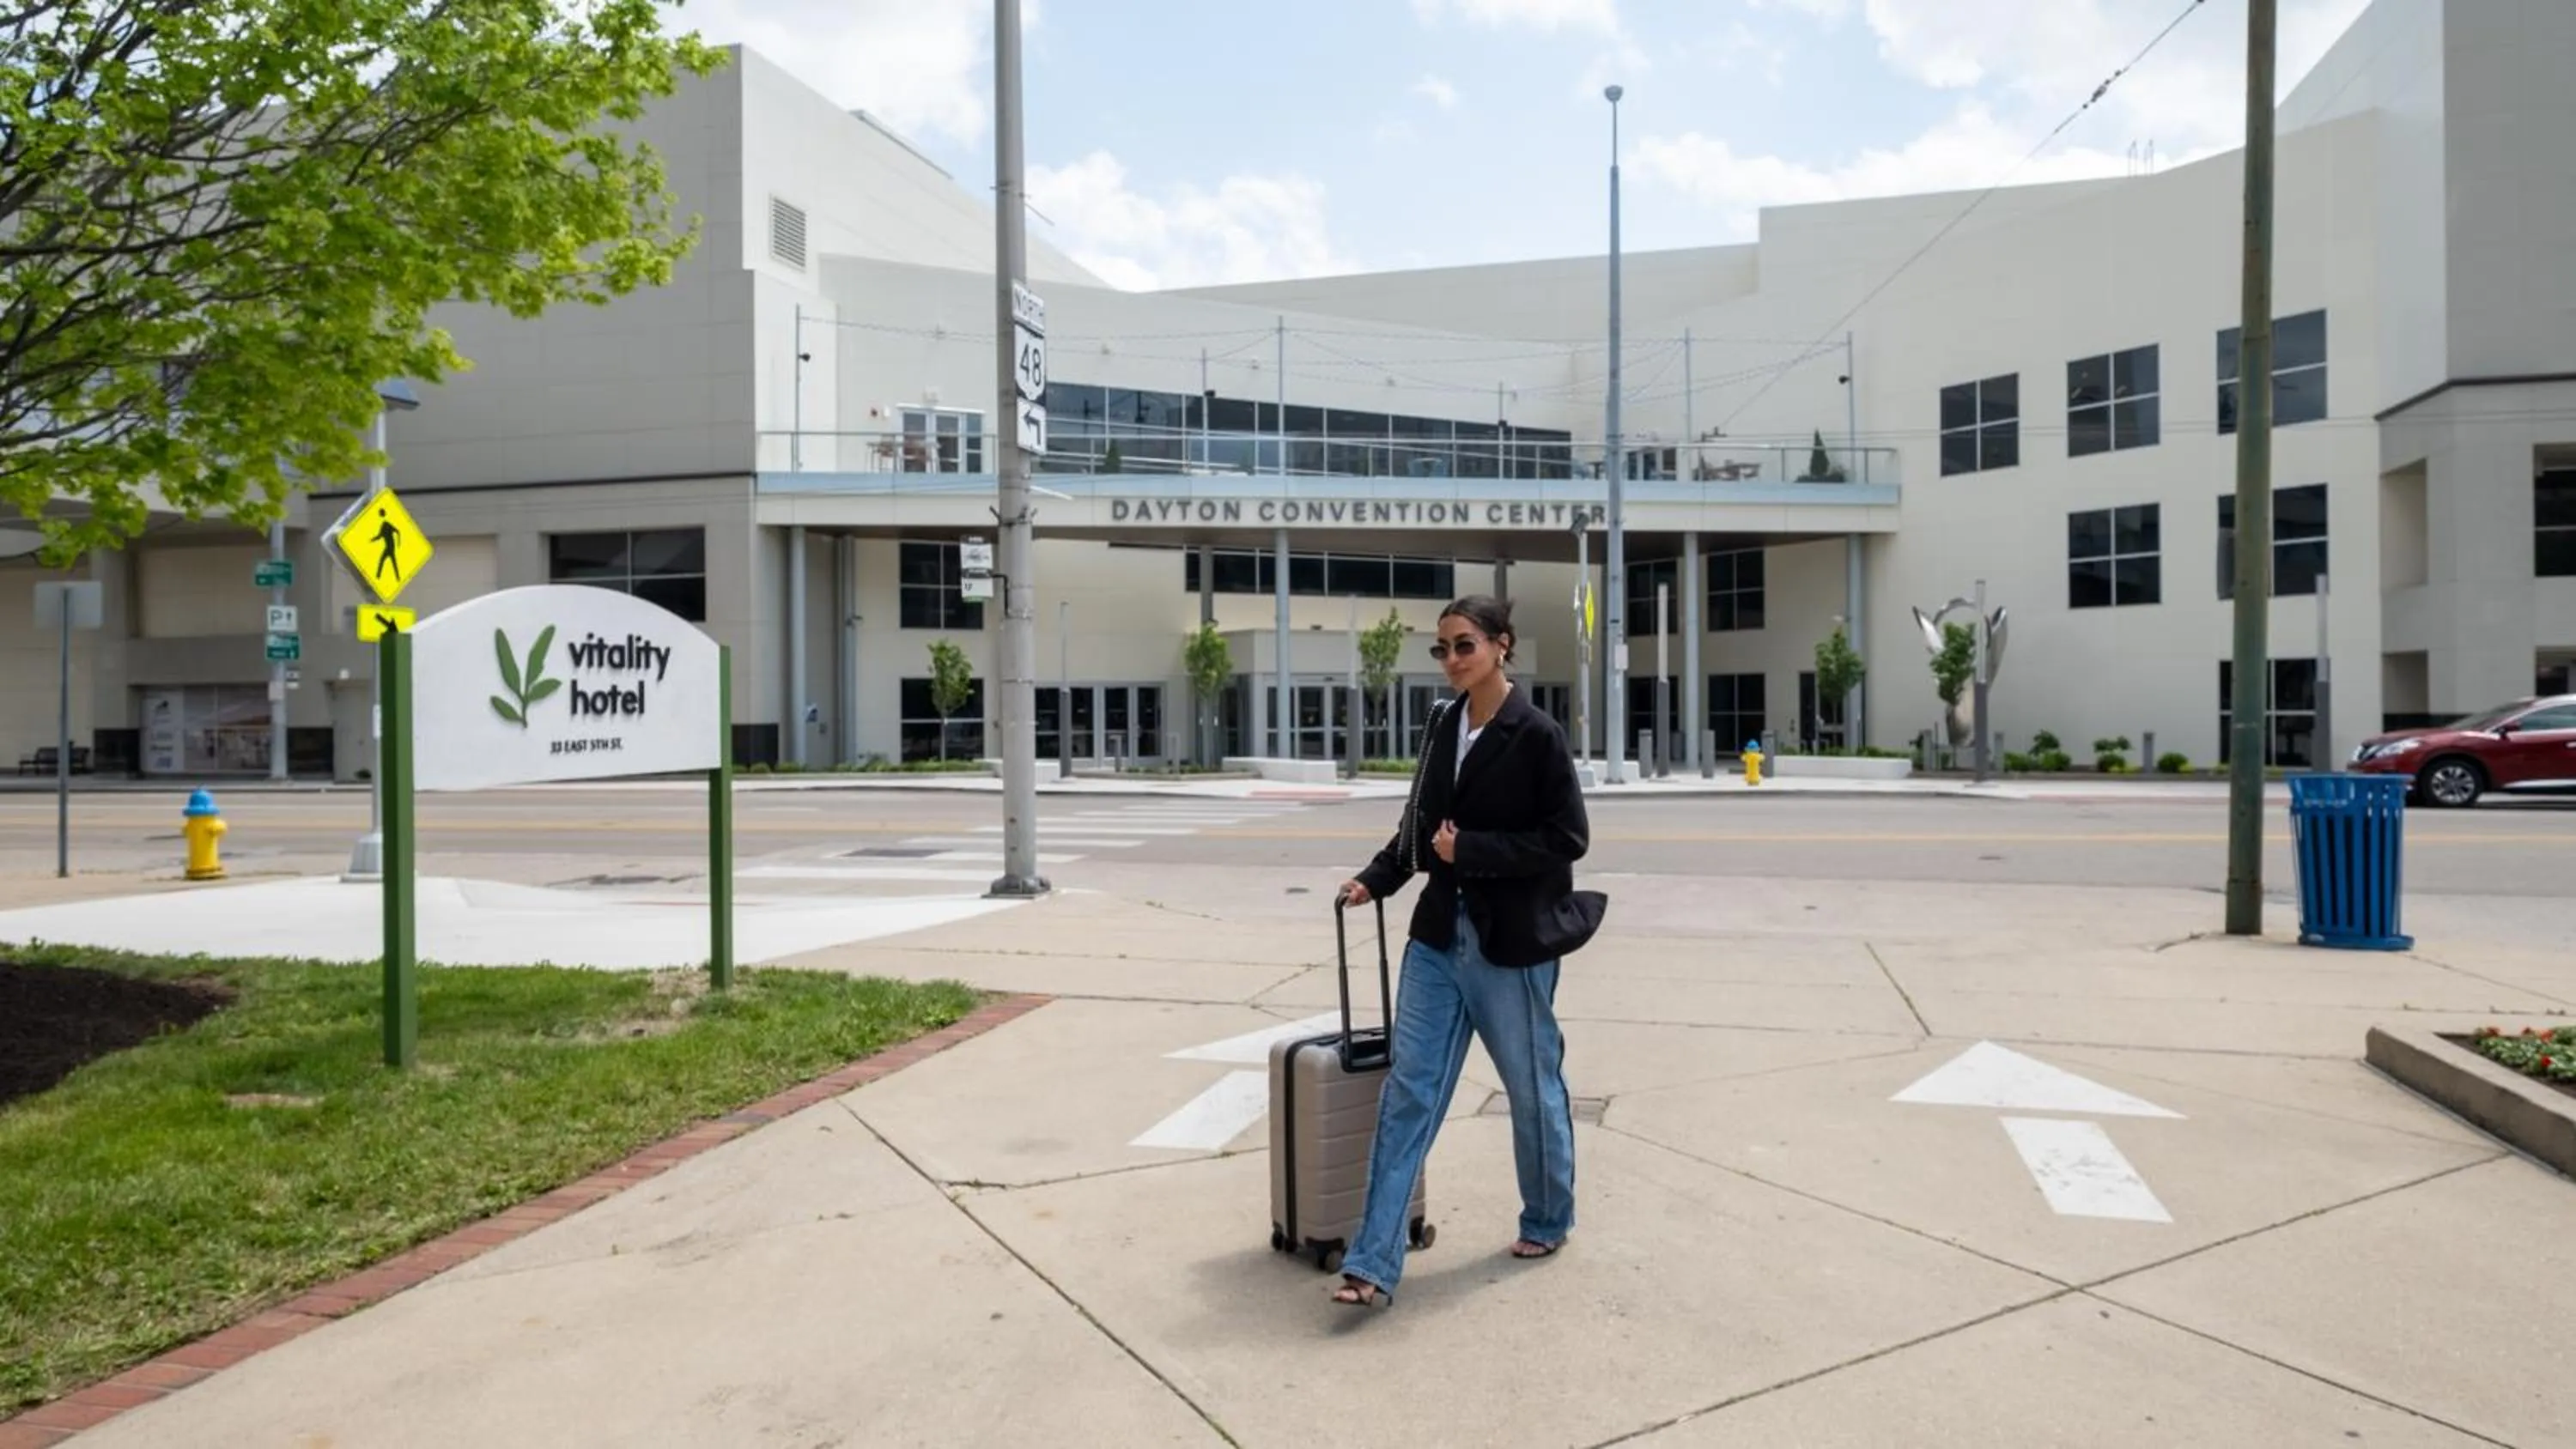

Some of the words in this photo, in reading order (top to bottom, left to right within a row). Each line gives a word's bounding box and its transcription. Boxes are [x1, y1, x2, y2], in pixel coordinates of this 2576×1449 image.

[1019, 343, 1042, 386] 48
[1112, 500, 1241, 521] DAYTON
[1259, 501, 1469, 522] CONVENTION
[568, 632, 671, 682] vitality
[570, 679, 645, 716] hotel
[564, 739, 587, 752] EAST
[611, 737, 623, 750] ST.
